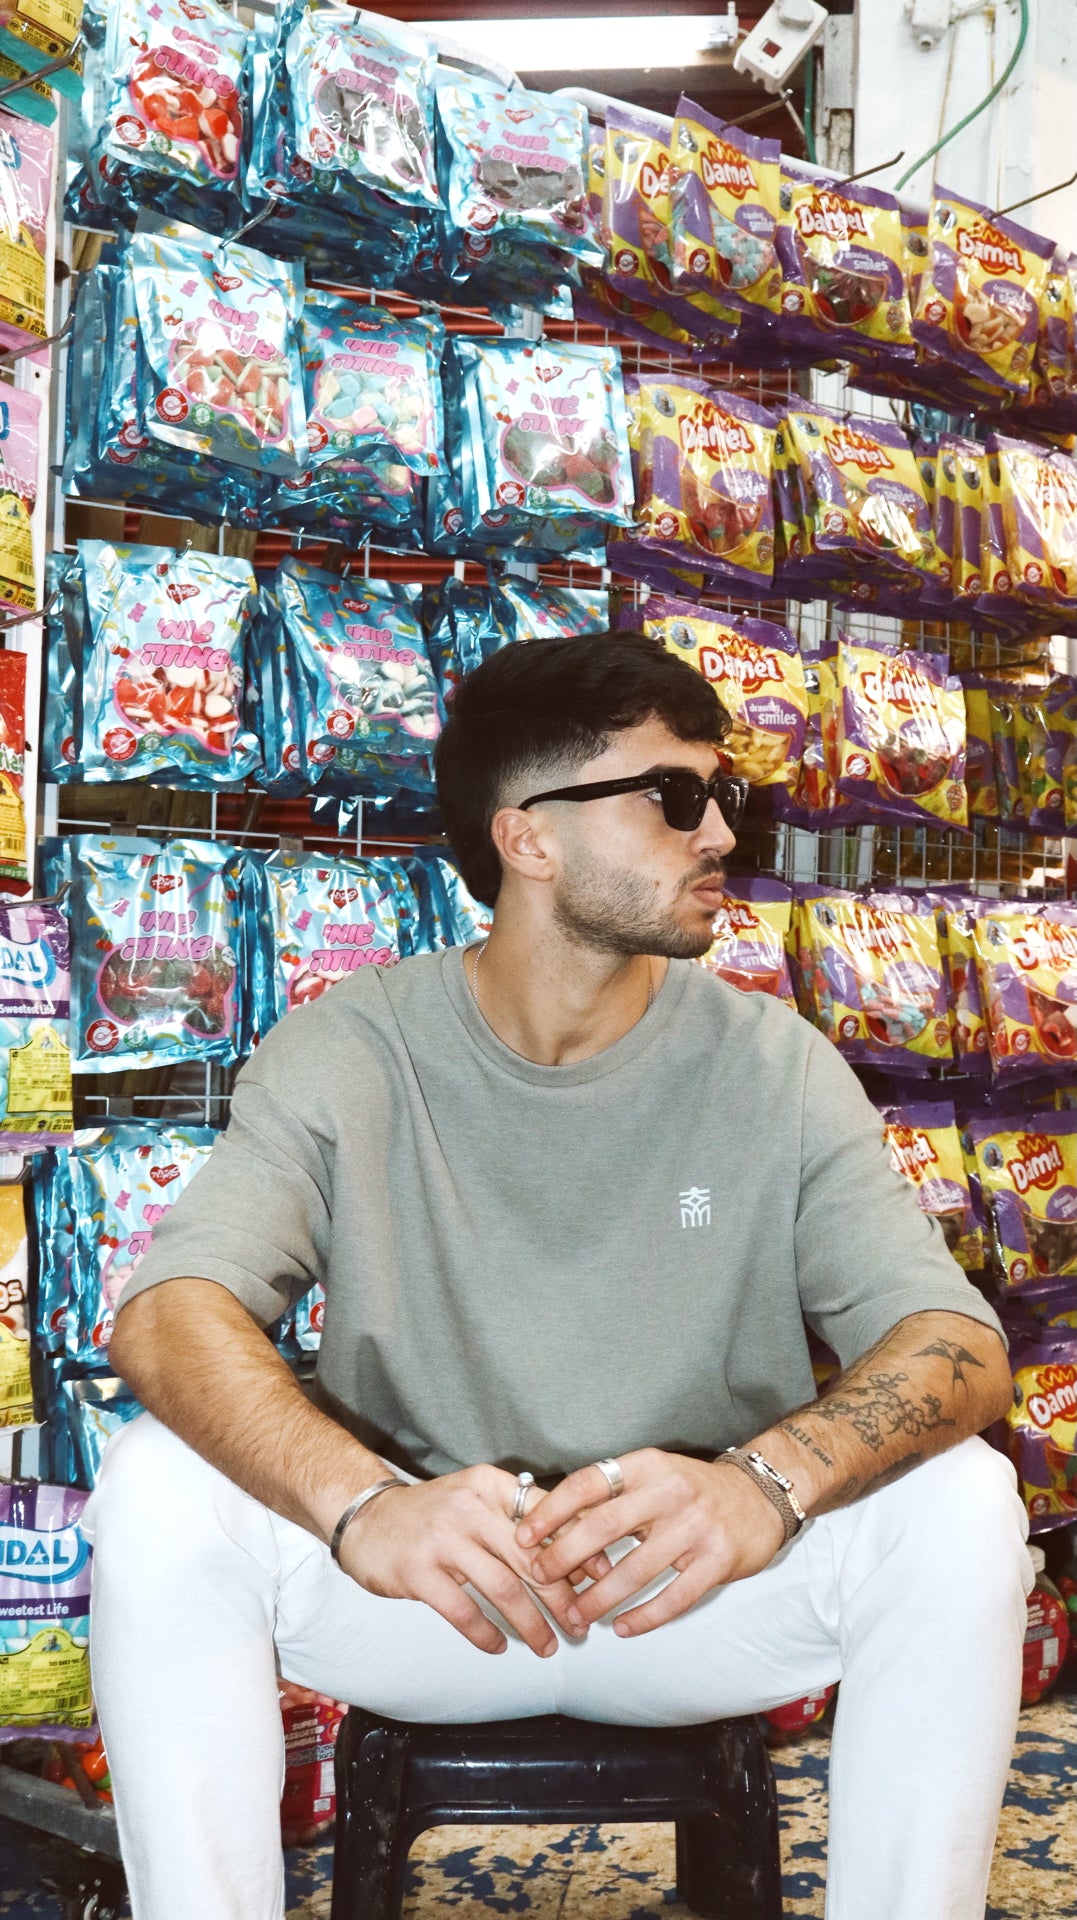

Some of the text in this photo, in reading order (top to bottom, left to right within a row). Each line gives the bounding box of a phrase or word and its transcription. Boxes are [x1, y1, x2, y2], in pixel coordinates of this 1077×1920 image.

[701, 156, 756, 187] Damel
[854, 258, 888, 271] smiles
[960, 233, 1022, 272] Damel
[344, 338, 397, 358] גומי
[681, 422, 751, 454] Damel
[829, 439, 892, 467] Damel
[345, 624, 393, 646] גומי
[702, 651, 782, 680] Damel
[758, 709, 797, 725] smiles
[139, 911, 194, 935] גומי
[322, 920, 374, 945] גומי
[0, 947, 42, 972] DAL
[121, 935, 212, 960] שמחה
[0, 1003, 38, 1014] Sweetest
[890, 1137, 936, 1172] amel
[1011, 1144, 1062, 1190] Damel
[812, 1447, 833, 1468] out
[0, 1602, 69, 1617] weetest Life
[292, 1718, 318, 1731] SUPER
